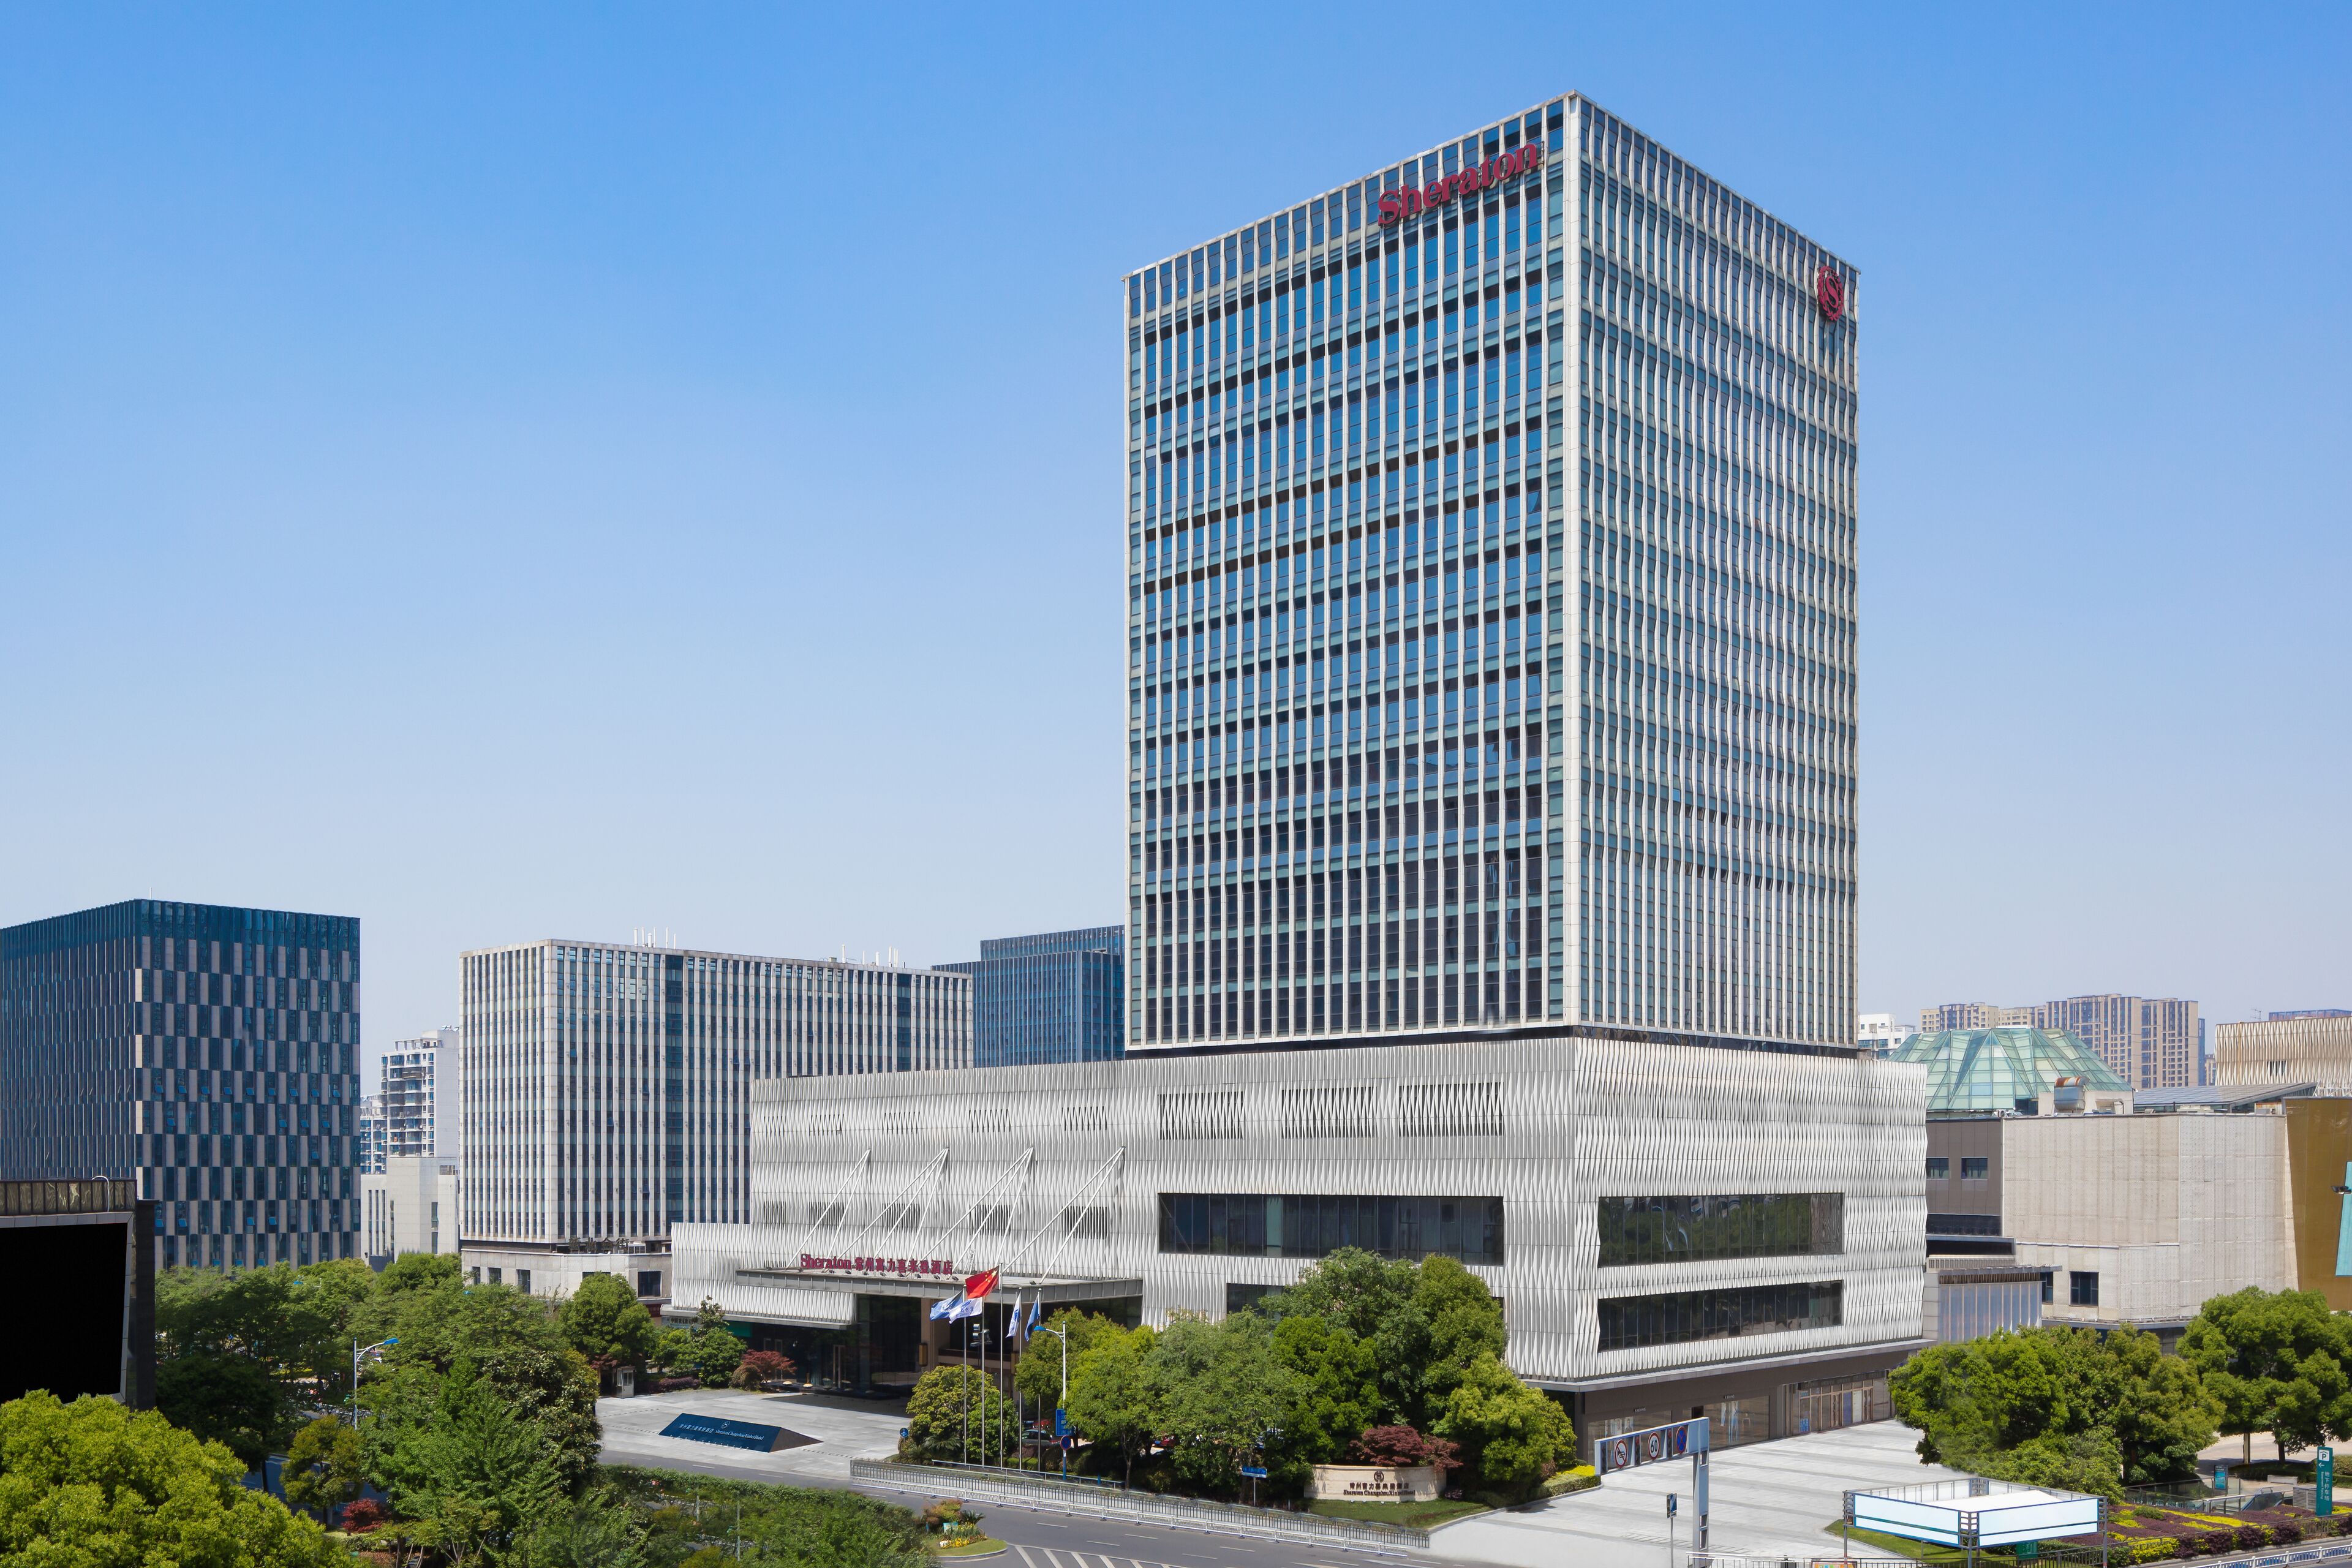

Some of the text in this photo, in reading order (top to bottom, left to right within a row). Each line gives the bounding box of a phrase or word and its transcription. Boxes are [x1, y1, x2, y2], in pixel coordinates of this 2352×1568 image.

[1378, 143, 1538, 226] Sheraton
[801, 1253, 953, 1275] Sheraton 常州富力喜来登酒店
[1650, 1439, 1657, 1453] 60
